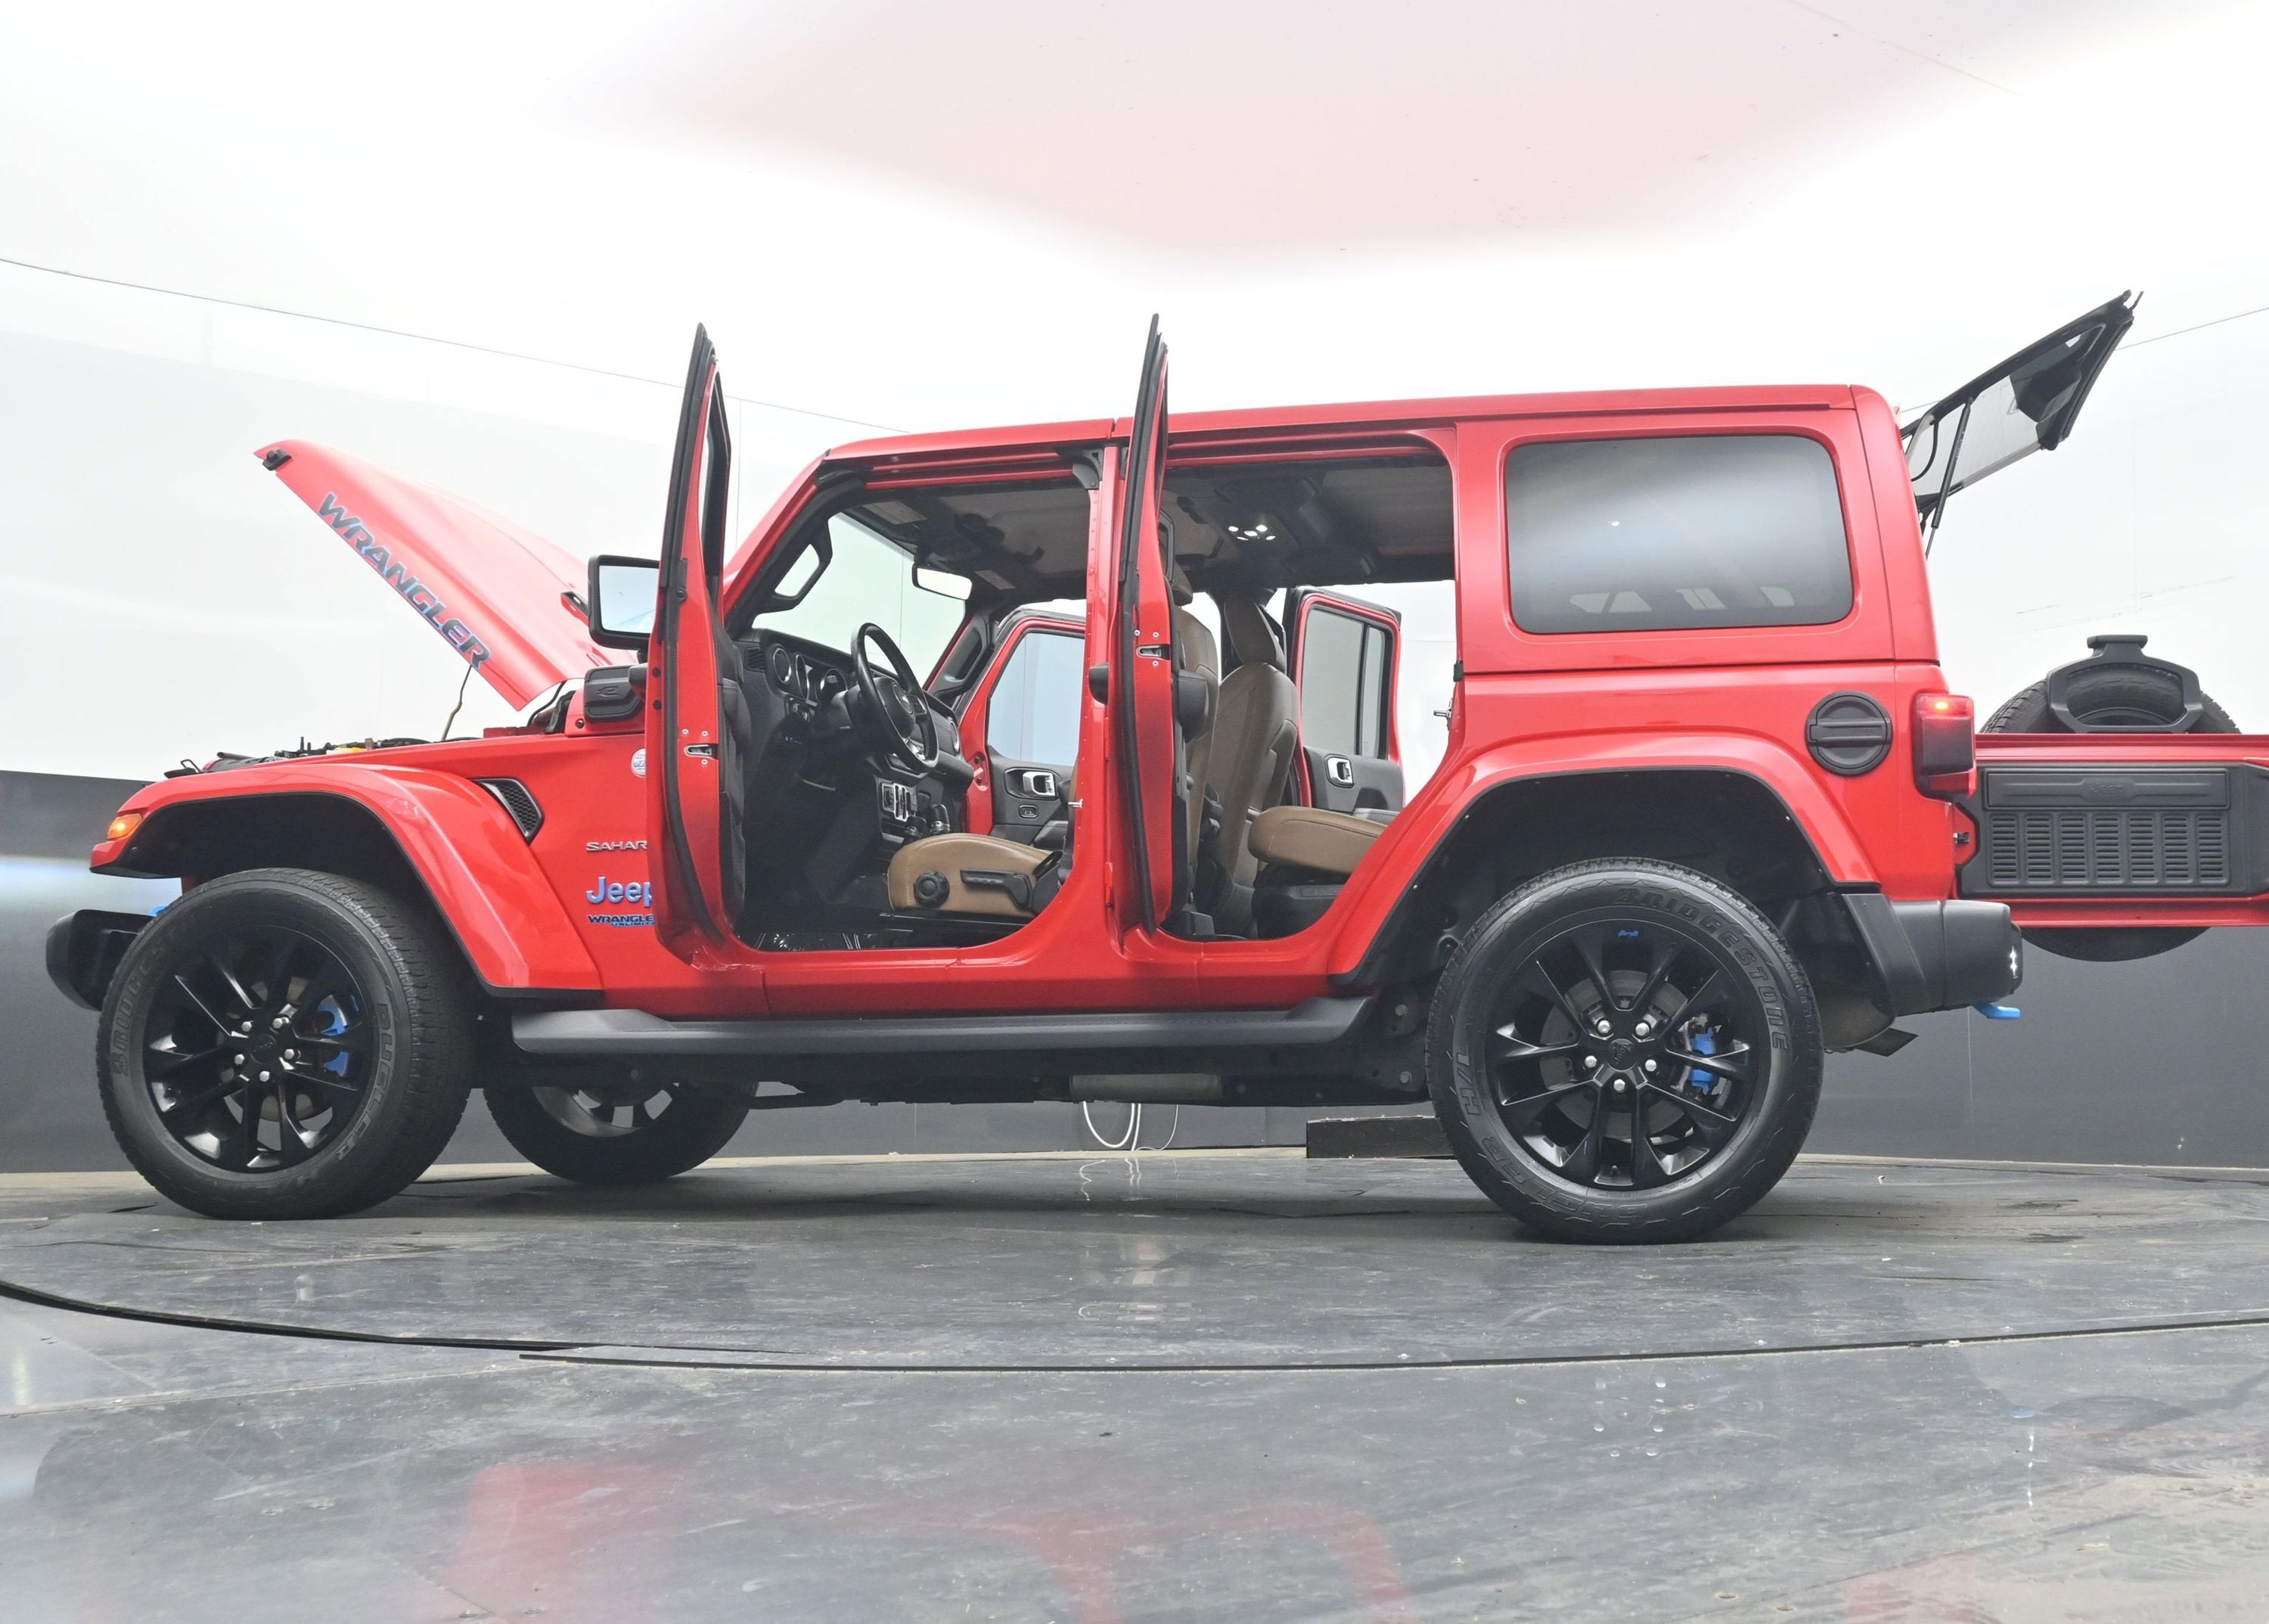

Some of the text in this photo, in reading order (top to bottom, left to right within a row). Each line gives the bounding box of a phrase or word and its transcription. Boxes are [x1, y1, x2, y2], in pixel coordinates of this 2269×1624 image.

[317, 492, 491, 670] WRANGLER
[585, 840, 648, 852] SAHAR
[587, 913, 654, 924] WRANGLE
[1613, 887, 1789, 1050] BRIDGESTONE
[336, 1002, 393, 1161] DUELER
[1481, 1135, 1649, 1219] DUELER
